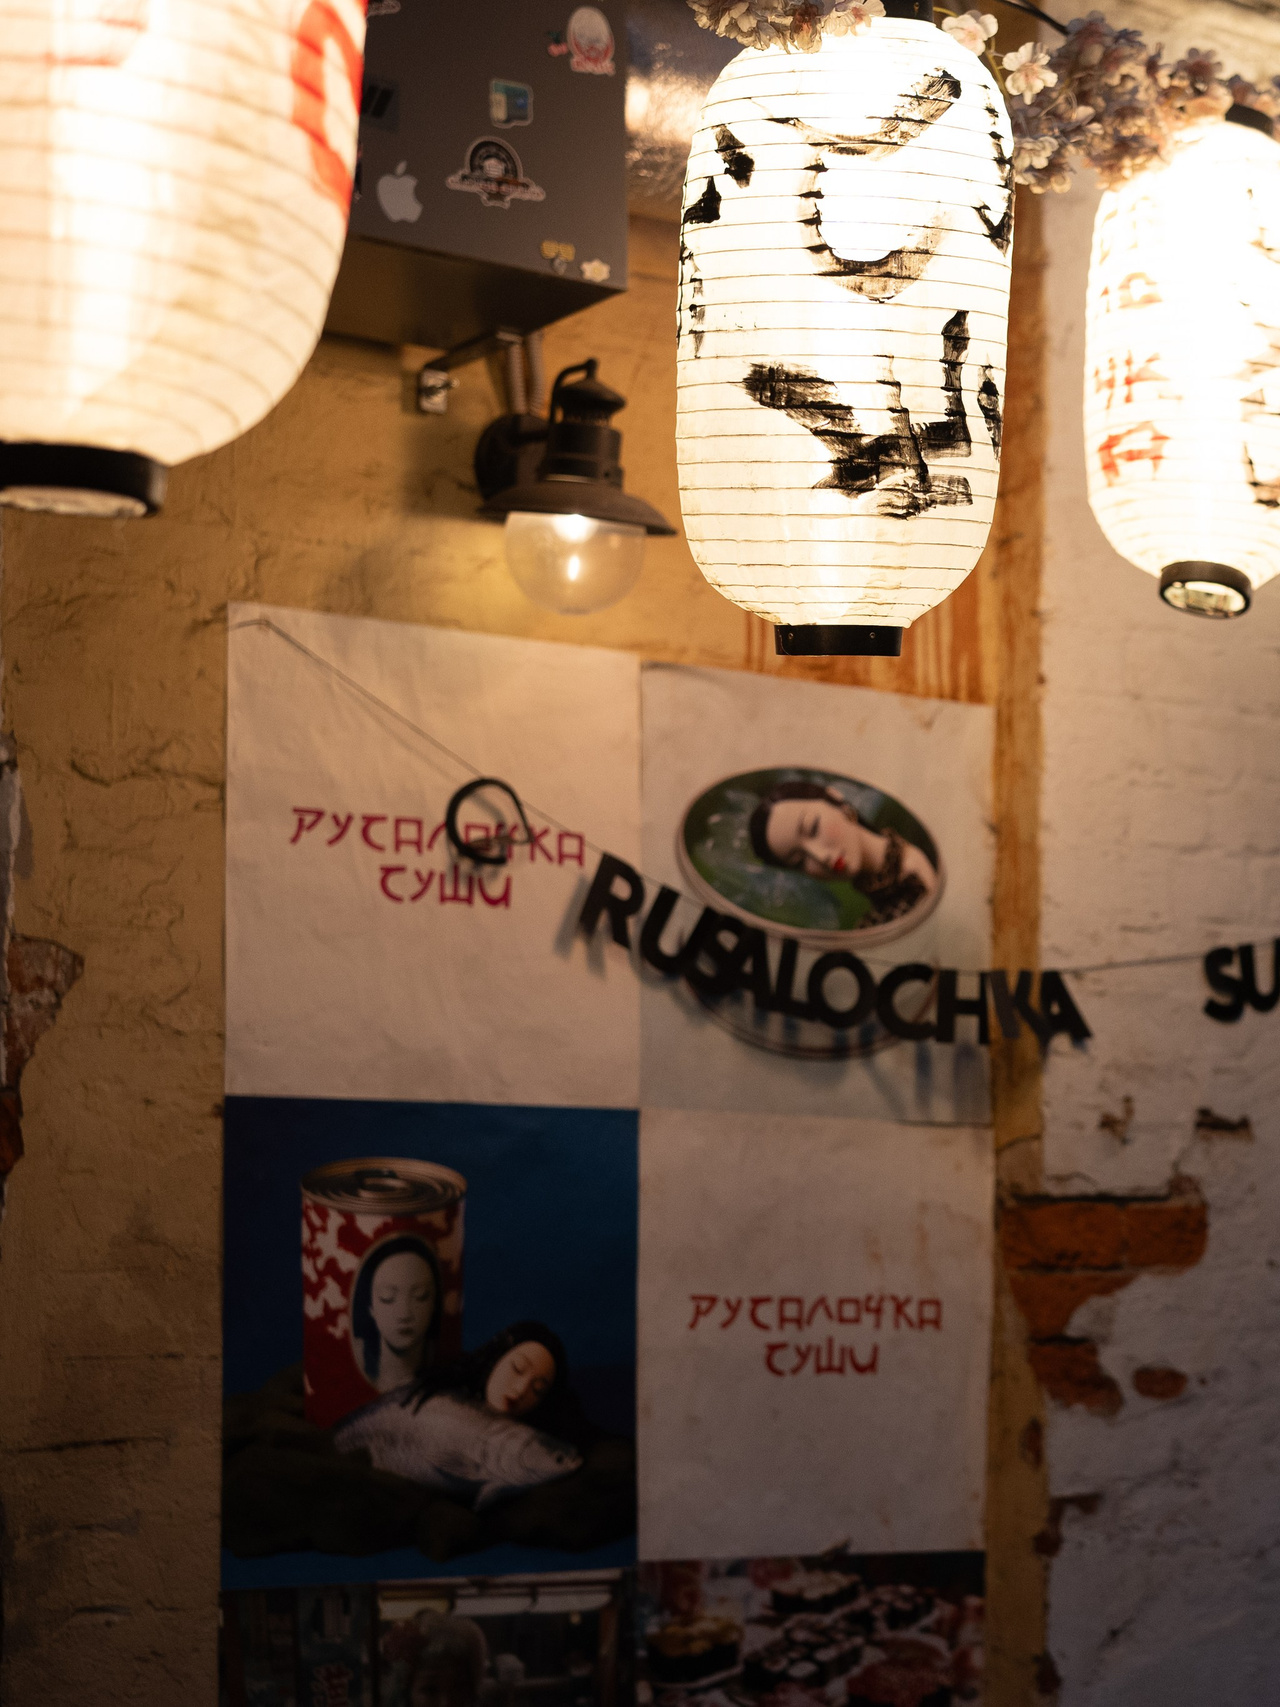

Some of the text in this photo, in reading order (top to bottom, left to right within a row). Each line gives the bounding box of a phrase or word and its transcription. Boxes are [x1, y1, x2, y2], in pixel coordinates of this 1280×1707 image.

[379, 863, 512, 908] СУШИ
[577, 853, 1092, 1043] RUSALOCHKA
[688, 1294, 942, 1331] РУСАЛОЧКА
[765, 1334, 878, 1376] СУШИ
